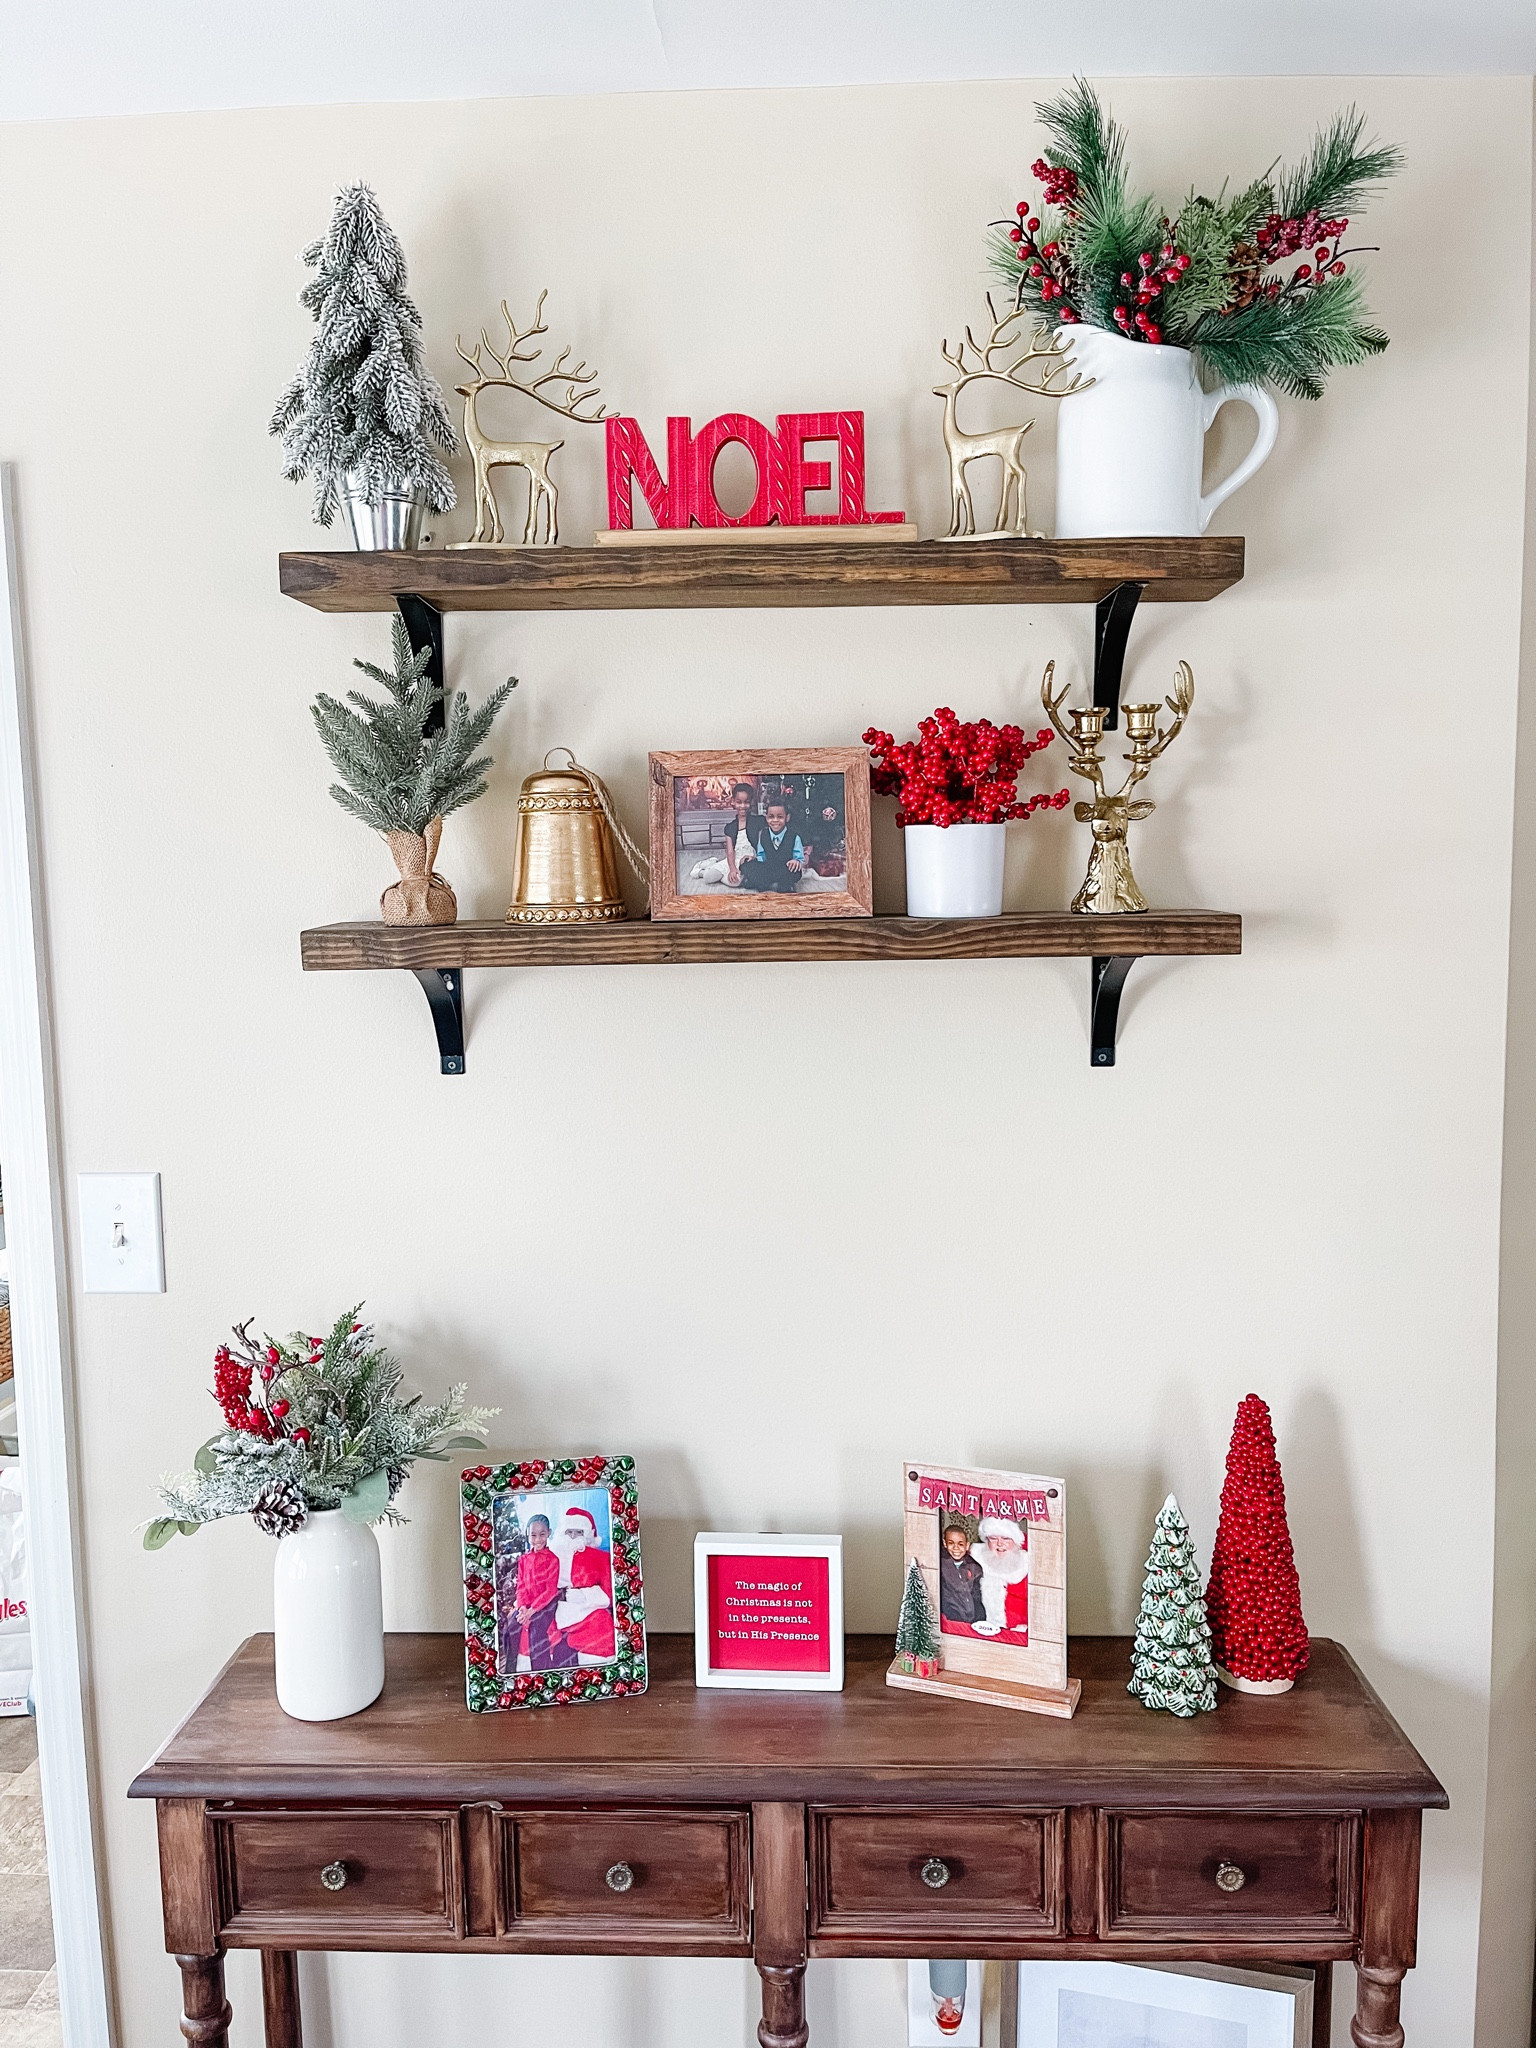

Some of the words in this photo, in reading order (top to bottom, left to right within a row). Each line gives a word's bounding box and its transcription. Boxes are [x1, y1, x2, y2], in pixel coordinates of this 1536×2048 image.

[605, 410, 905, 530] NOEL
[735, 1581, 755, 1590] The
[757, 1581, 789, 1592] magic
[791, 1582, 803, 1591] of
[725, 1597, 781, 1608] Christmas
[783, 1598, 793, 1608] is
[794, 1599, 813, 1608] not
[728, 1613, 739, 1622] in
[741, 1614, 759, 1623] the
[760, 1615, 811, 1625] presents,
[718, 1630, 737, 1639] but
[737, 1630, 749, 1639] in
[750, 1630, 769, 1640] His
[770, 1631, 820, 1641] Presence
